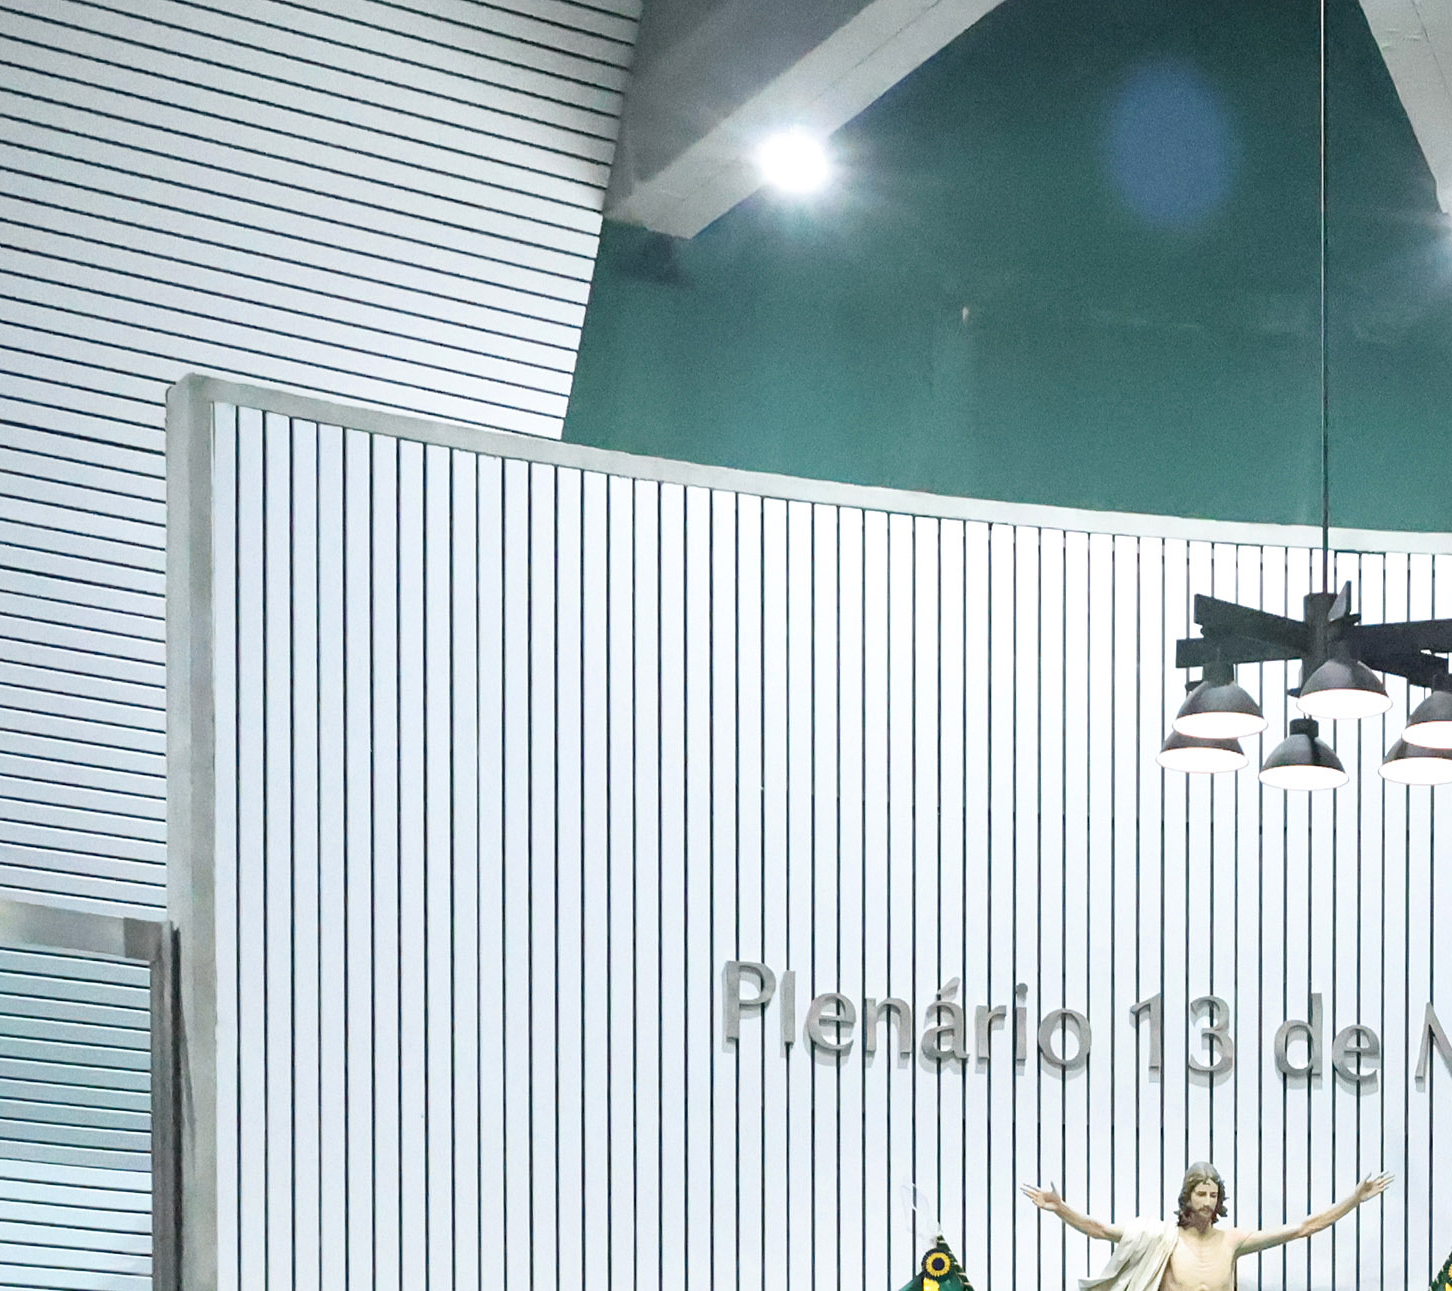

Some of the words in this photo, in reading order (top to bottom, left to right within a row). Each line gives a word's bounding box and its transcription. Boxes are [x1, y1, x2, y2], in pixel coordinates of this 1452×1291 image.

[722, 961, 1093, 1067] Plenário
[1130, 992, 1235, 1072] 13
[1274, 993, 1380, 1081] de
